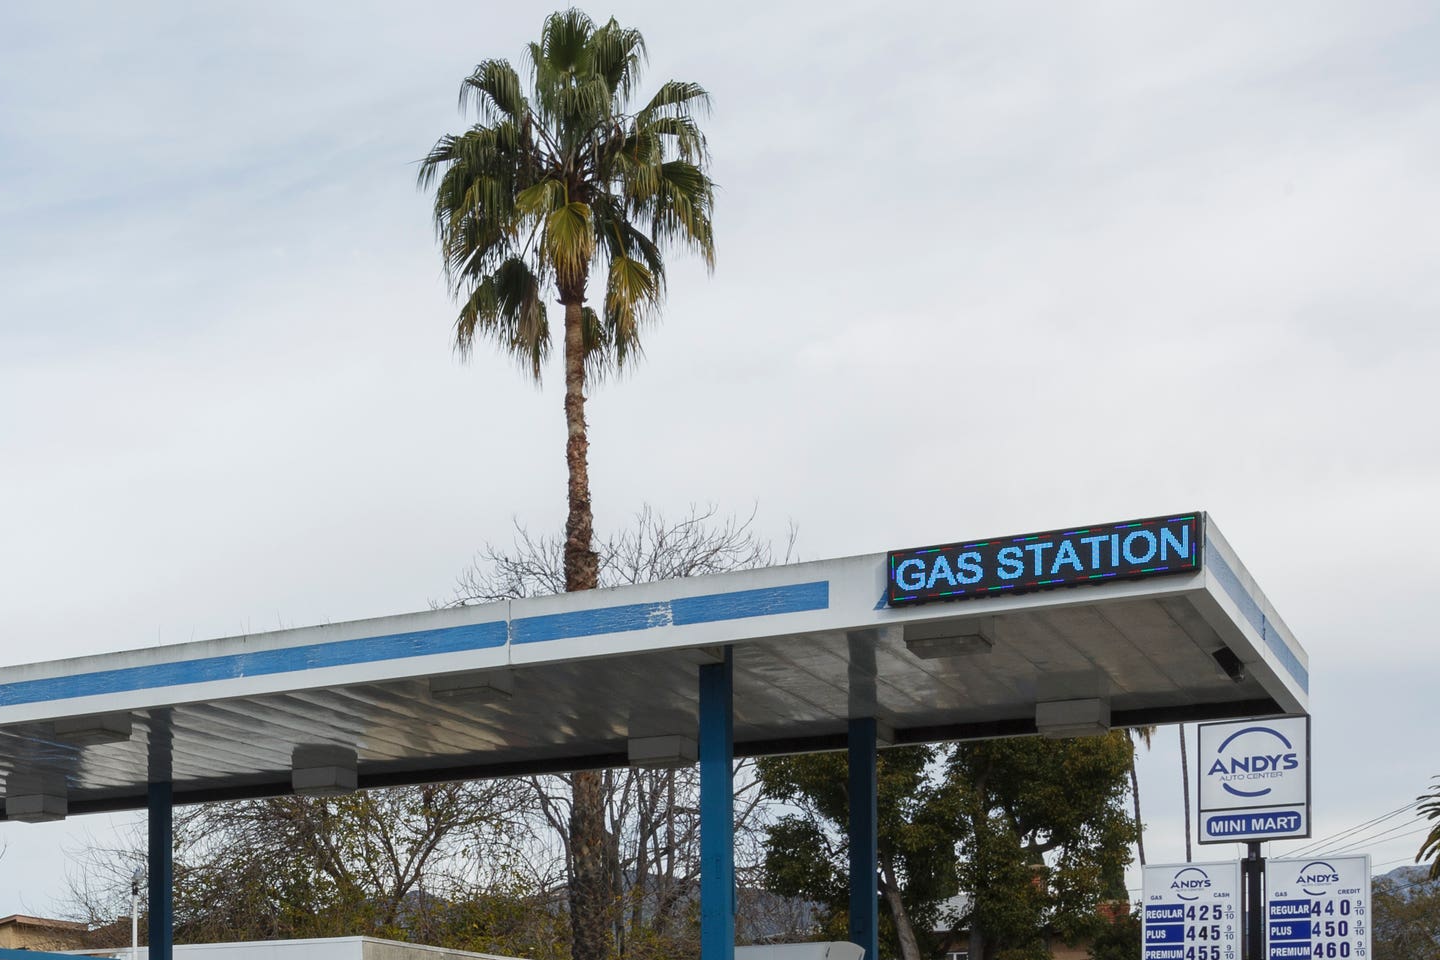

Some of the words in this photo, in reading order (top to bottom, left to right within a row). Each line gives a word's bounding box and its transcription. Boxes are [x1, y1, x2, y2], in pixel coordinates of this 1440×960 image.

[896, 551, 984, 591] GAS
[997, 525, 1188, 580] STATION
[1207, 753, 1299, 776] ANDYS
[1246, 771, 1283, 780] CENTER
[1211, 819, 1246, 834] MINI
[1251, 816, 1298, 831] MART
[1170, 880, 1212, 889] ANDYS
[1296, 873, 1339, 884] ANDYS
[1146, 909, 1183, 919] REGULAR
[1186, 904, 1222, 921] 425
[1270, 904, 1310, 915] REGULAR
[1311, 899, 1350, 917] 440
[1146, 929, 1166, 939] PLUS
[1186, 925, 1220, 941] 445
[1271, 926, 1292, 936] PLUS
[1312, 920, 1348, 938] 450
[1145, 949, 1183, 959] PREMIUM
[1186, 946, 1220, 960] 455
[1271, 946, 1310, 957] PREMIUM
[1313, 941, 1350, 959] 460
